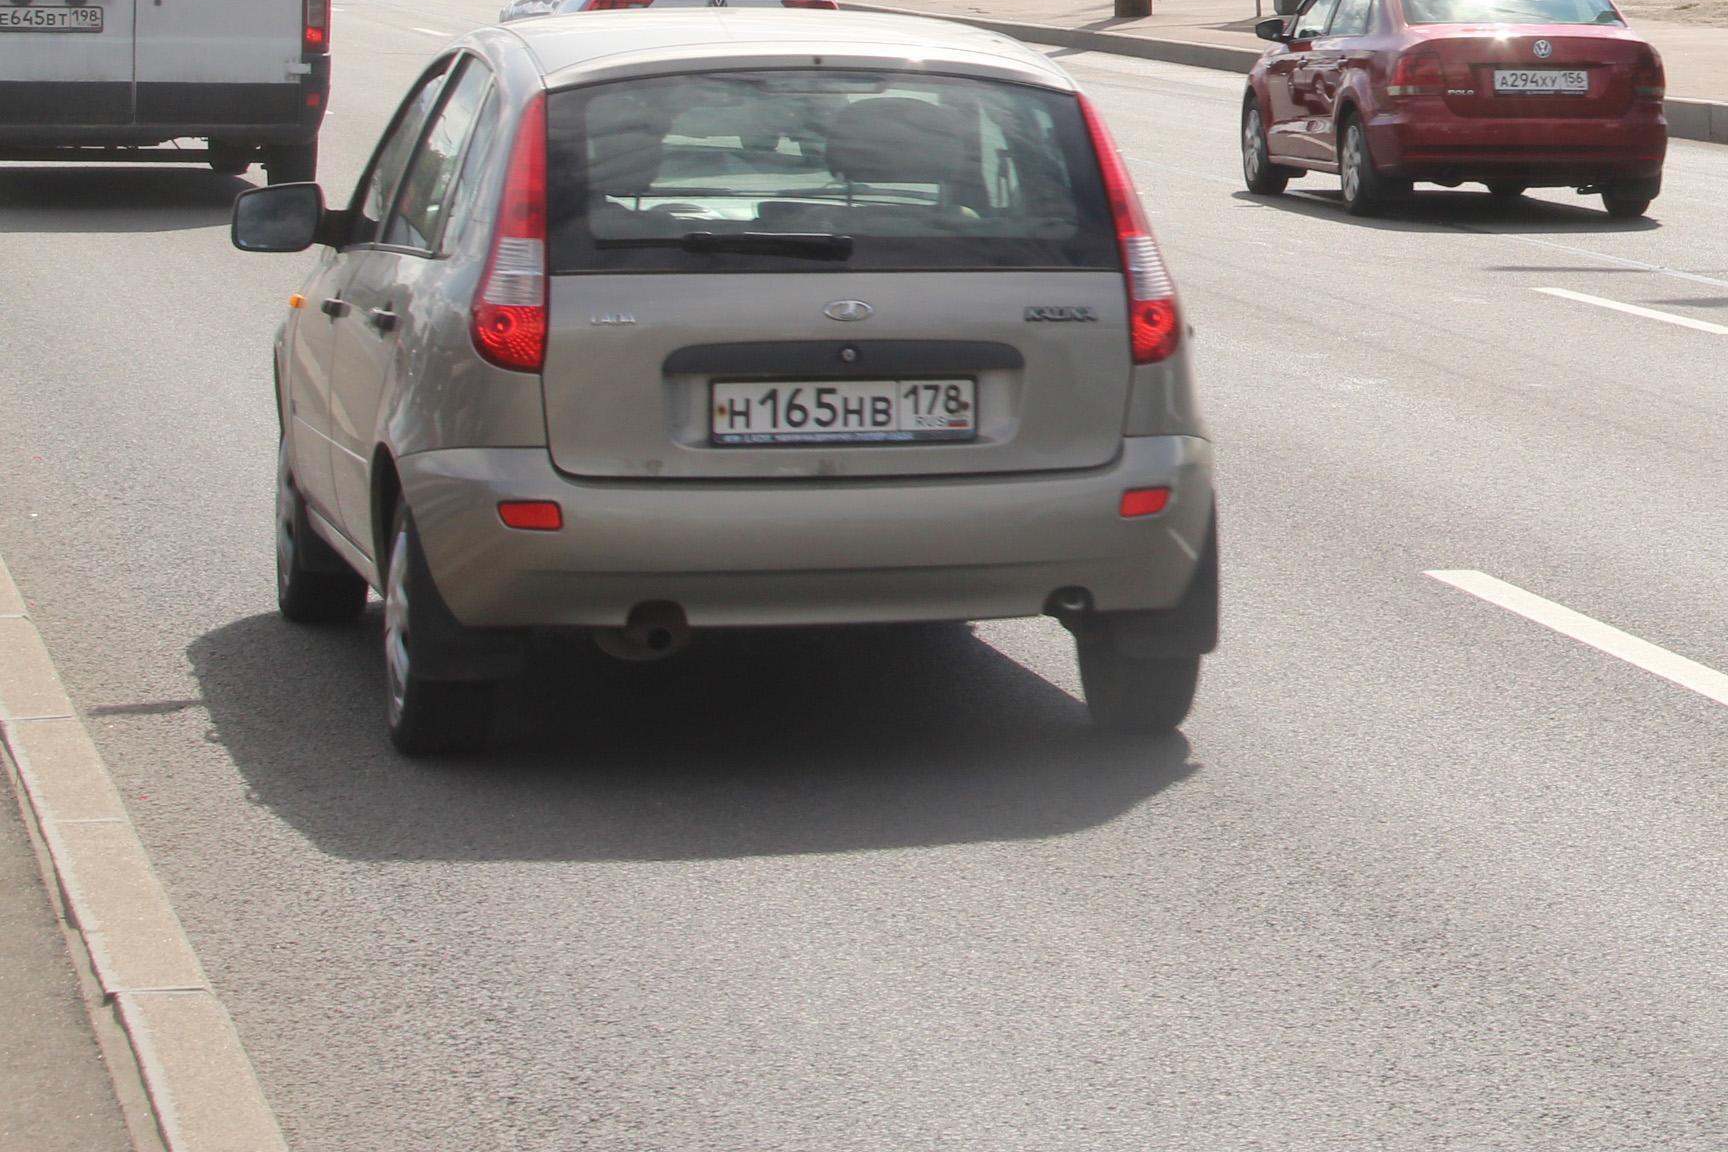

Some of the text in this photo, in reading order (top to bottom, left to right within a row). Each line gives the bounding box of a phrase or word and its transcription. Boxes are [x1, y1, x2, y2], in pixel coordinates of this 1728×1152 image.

[0, 10, 98, 26] Е645ВТ 198
[1500, 72, 1584, 88] А294ХУ 156
[727, 384, 961, 429] Н165НВ 178
